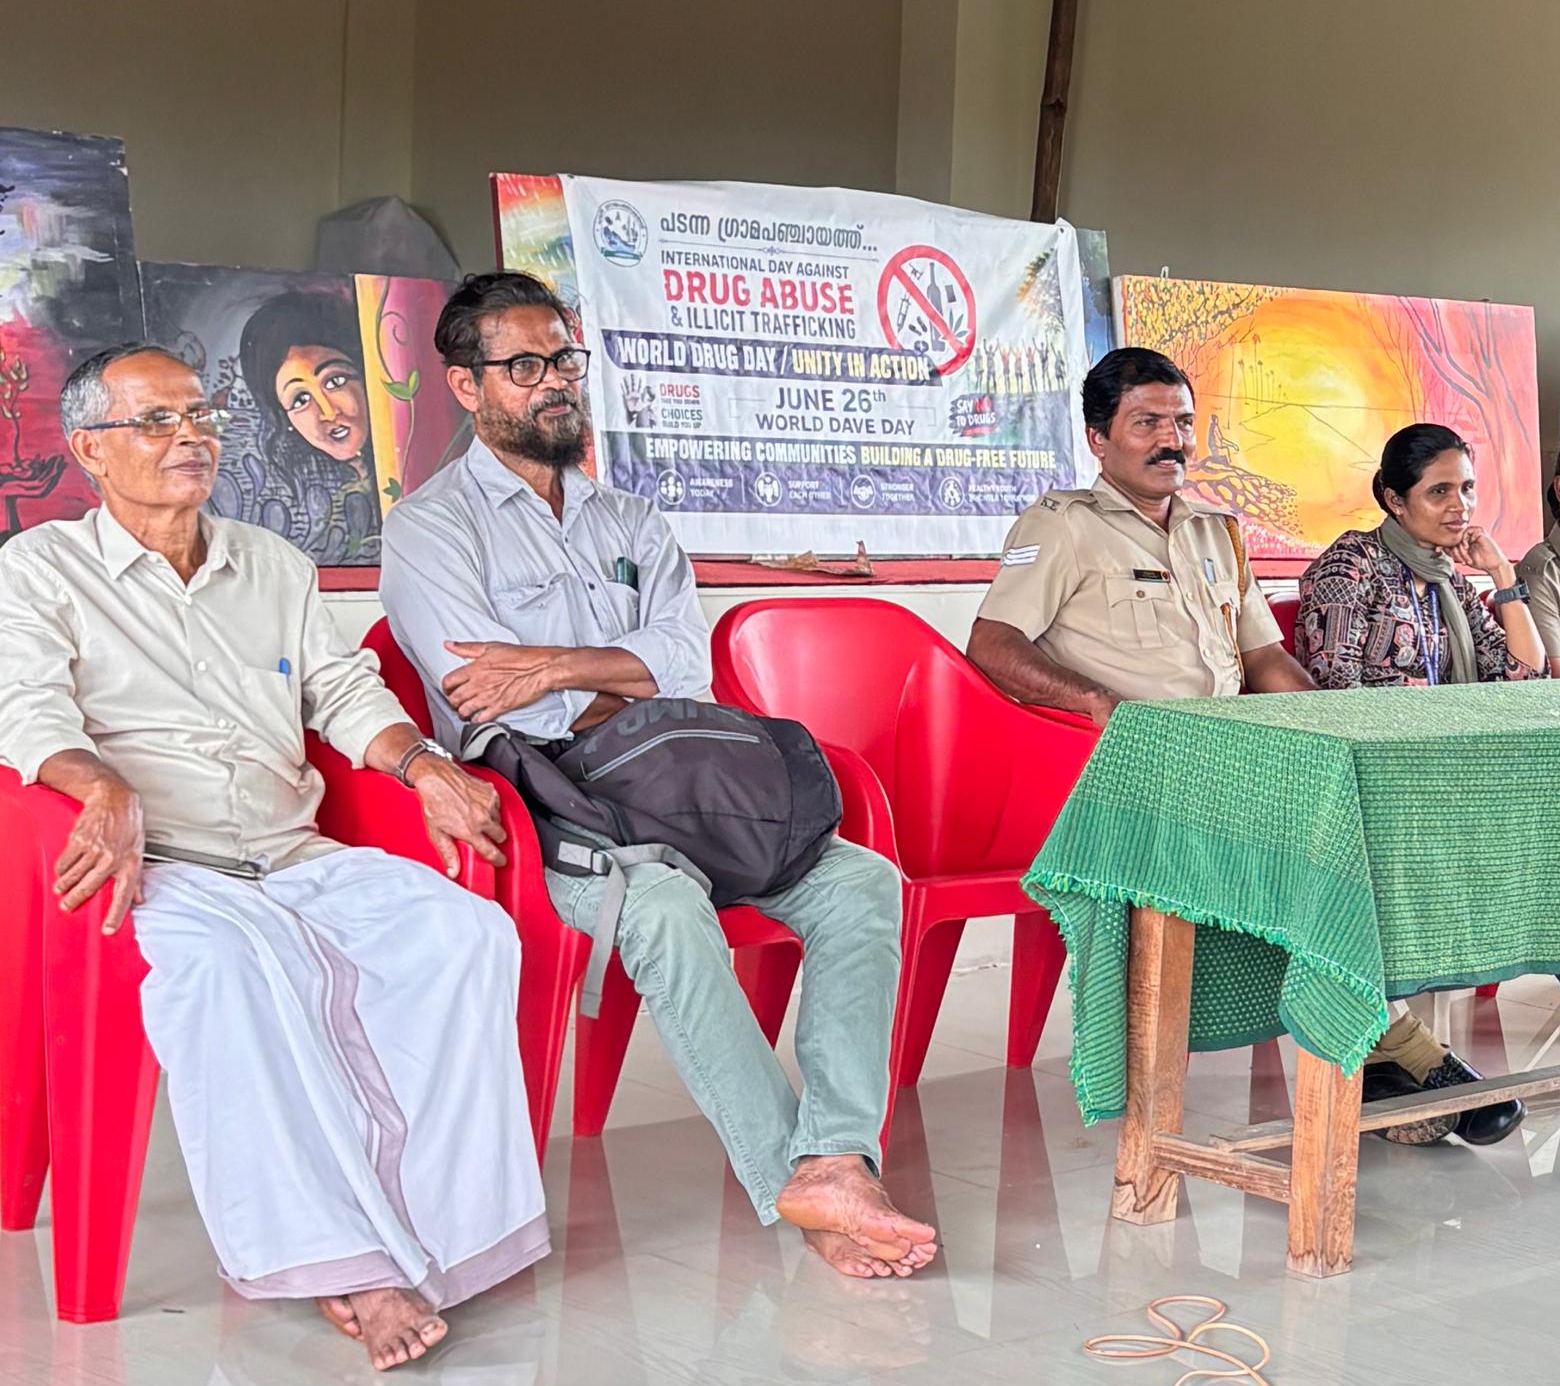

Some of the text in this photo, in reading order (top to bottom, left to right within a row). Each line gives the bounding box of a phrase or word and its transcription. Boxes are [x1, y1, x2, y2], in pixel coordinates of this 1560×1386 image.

[660, 212, 711, 236] പടന്ന
[661, 250, 850, 280] INTERNATIONAL DAY AGAINST
[663, 269, 855, 315] DRUG ABUSE
[671, 305, 856, 340] & ILLICIT TRAFFICKING
[618, 335, 931, 381] WORLD DRUG DAY / UNITY IN ACTION
[659, 383, 700, 398] DRUGS
[775, 386, 887, 413] JUNE 26th
[661, 408, 703, 421] CHOICES
[956, 399, 974, 414] SAY
[756, 414, 915, 437] WORLD DAVE DAY
[955, 413, 996, 427] TO DRUGS
[645, 438, 1057, 470] EMPOWERING COMMUNITIES BUILDING A DRUG-FREE FUTURE
[880, 482, 915, 492] STRONGER
